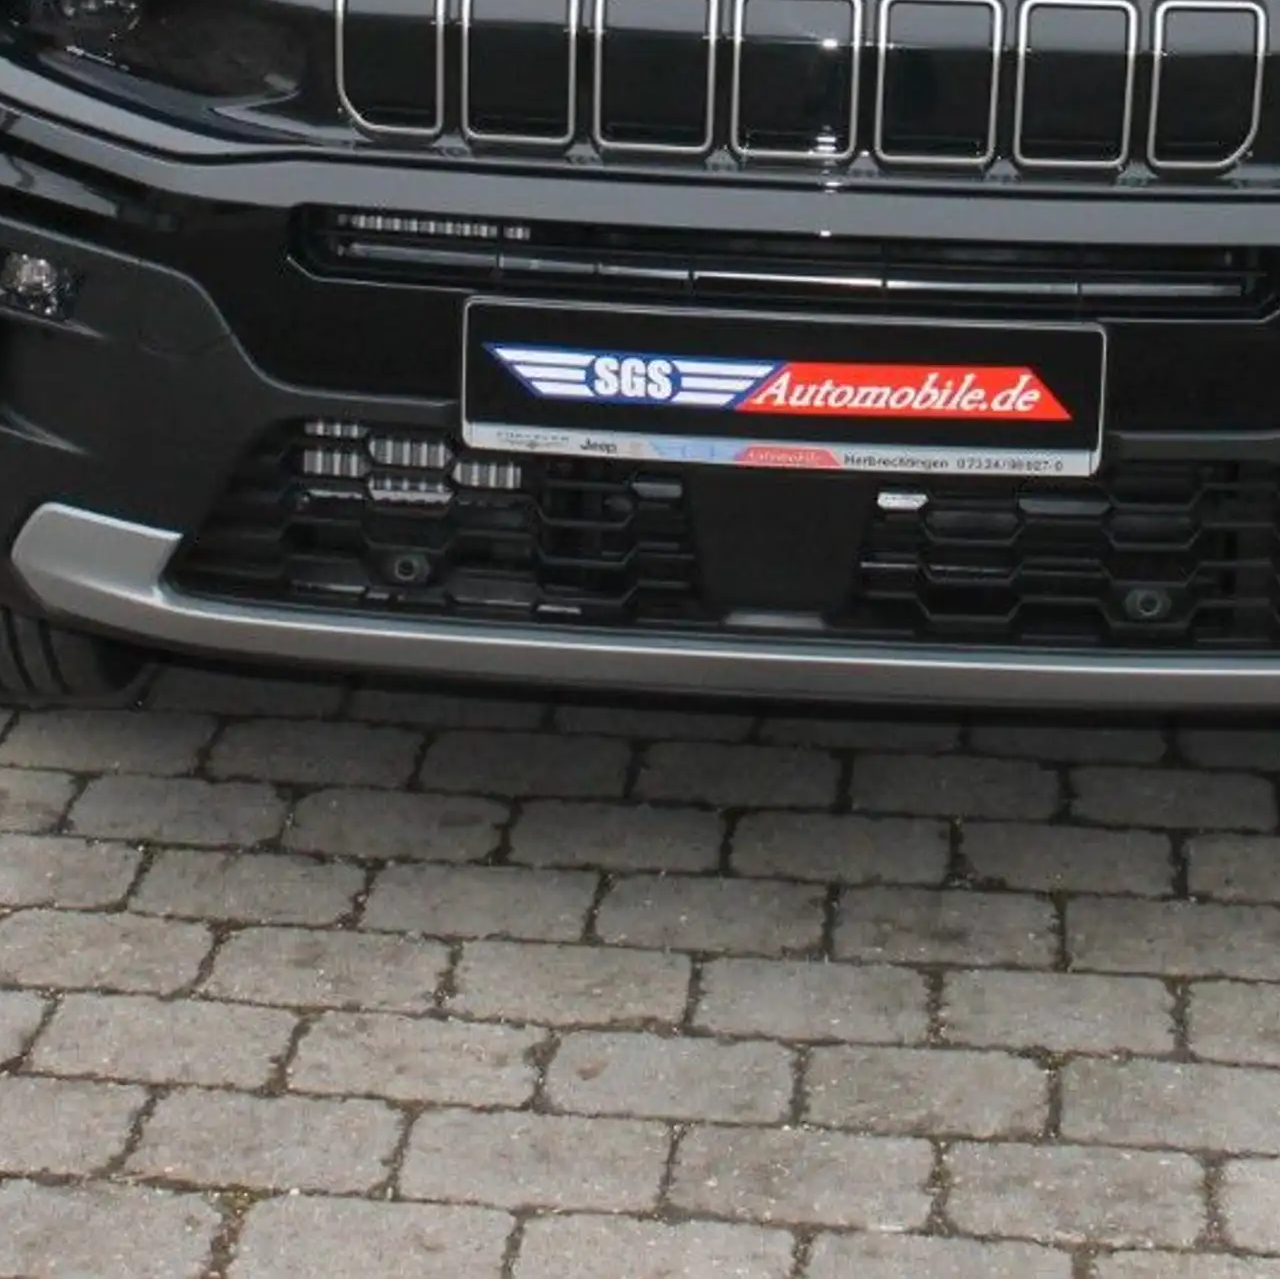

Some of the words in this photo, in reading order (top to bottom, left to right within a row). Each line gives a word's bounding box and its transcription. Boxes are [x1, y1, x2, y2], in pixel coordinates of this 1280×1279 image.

[592, 356, 672, 400] SGS
[755, 370, 1041, 413] Automobile.de
[580, 438, 618, 455] Jeep
